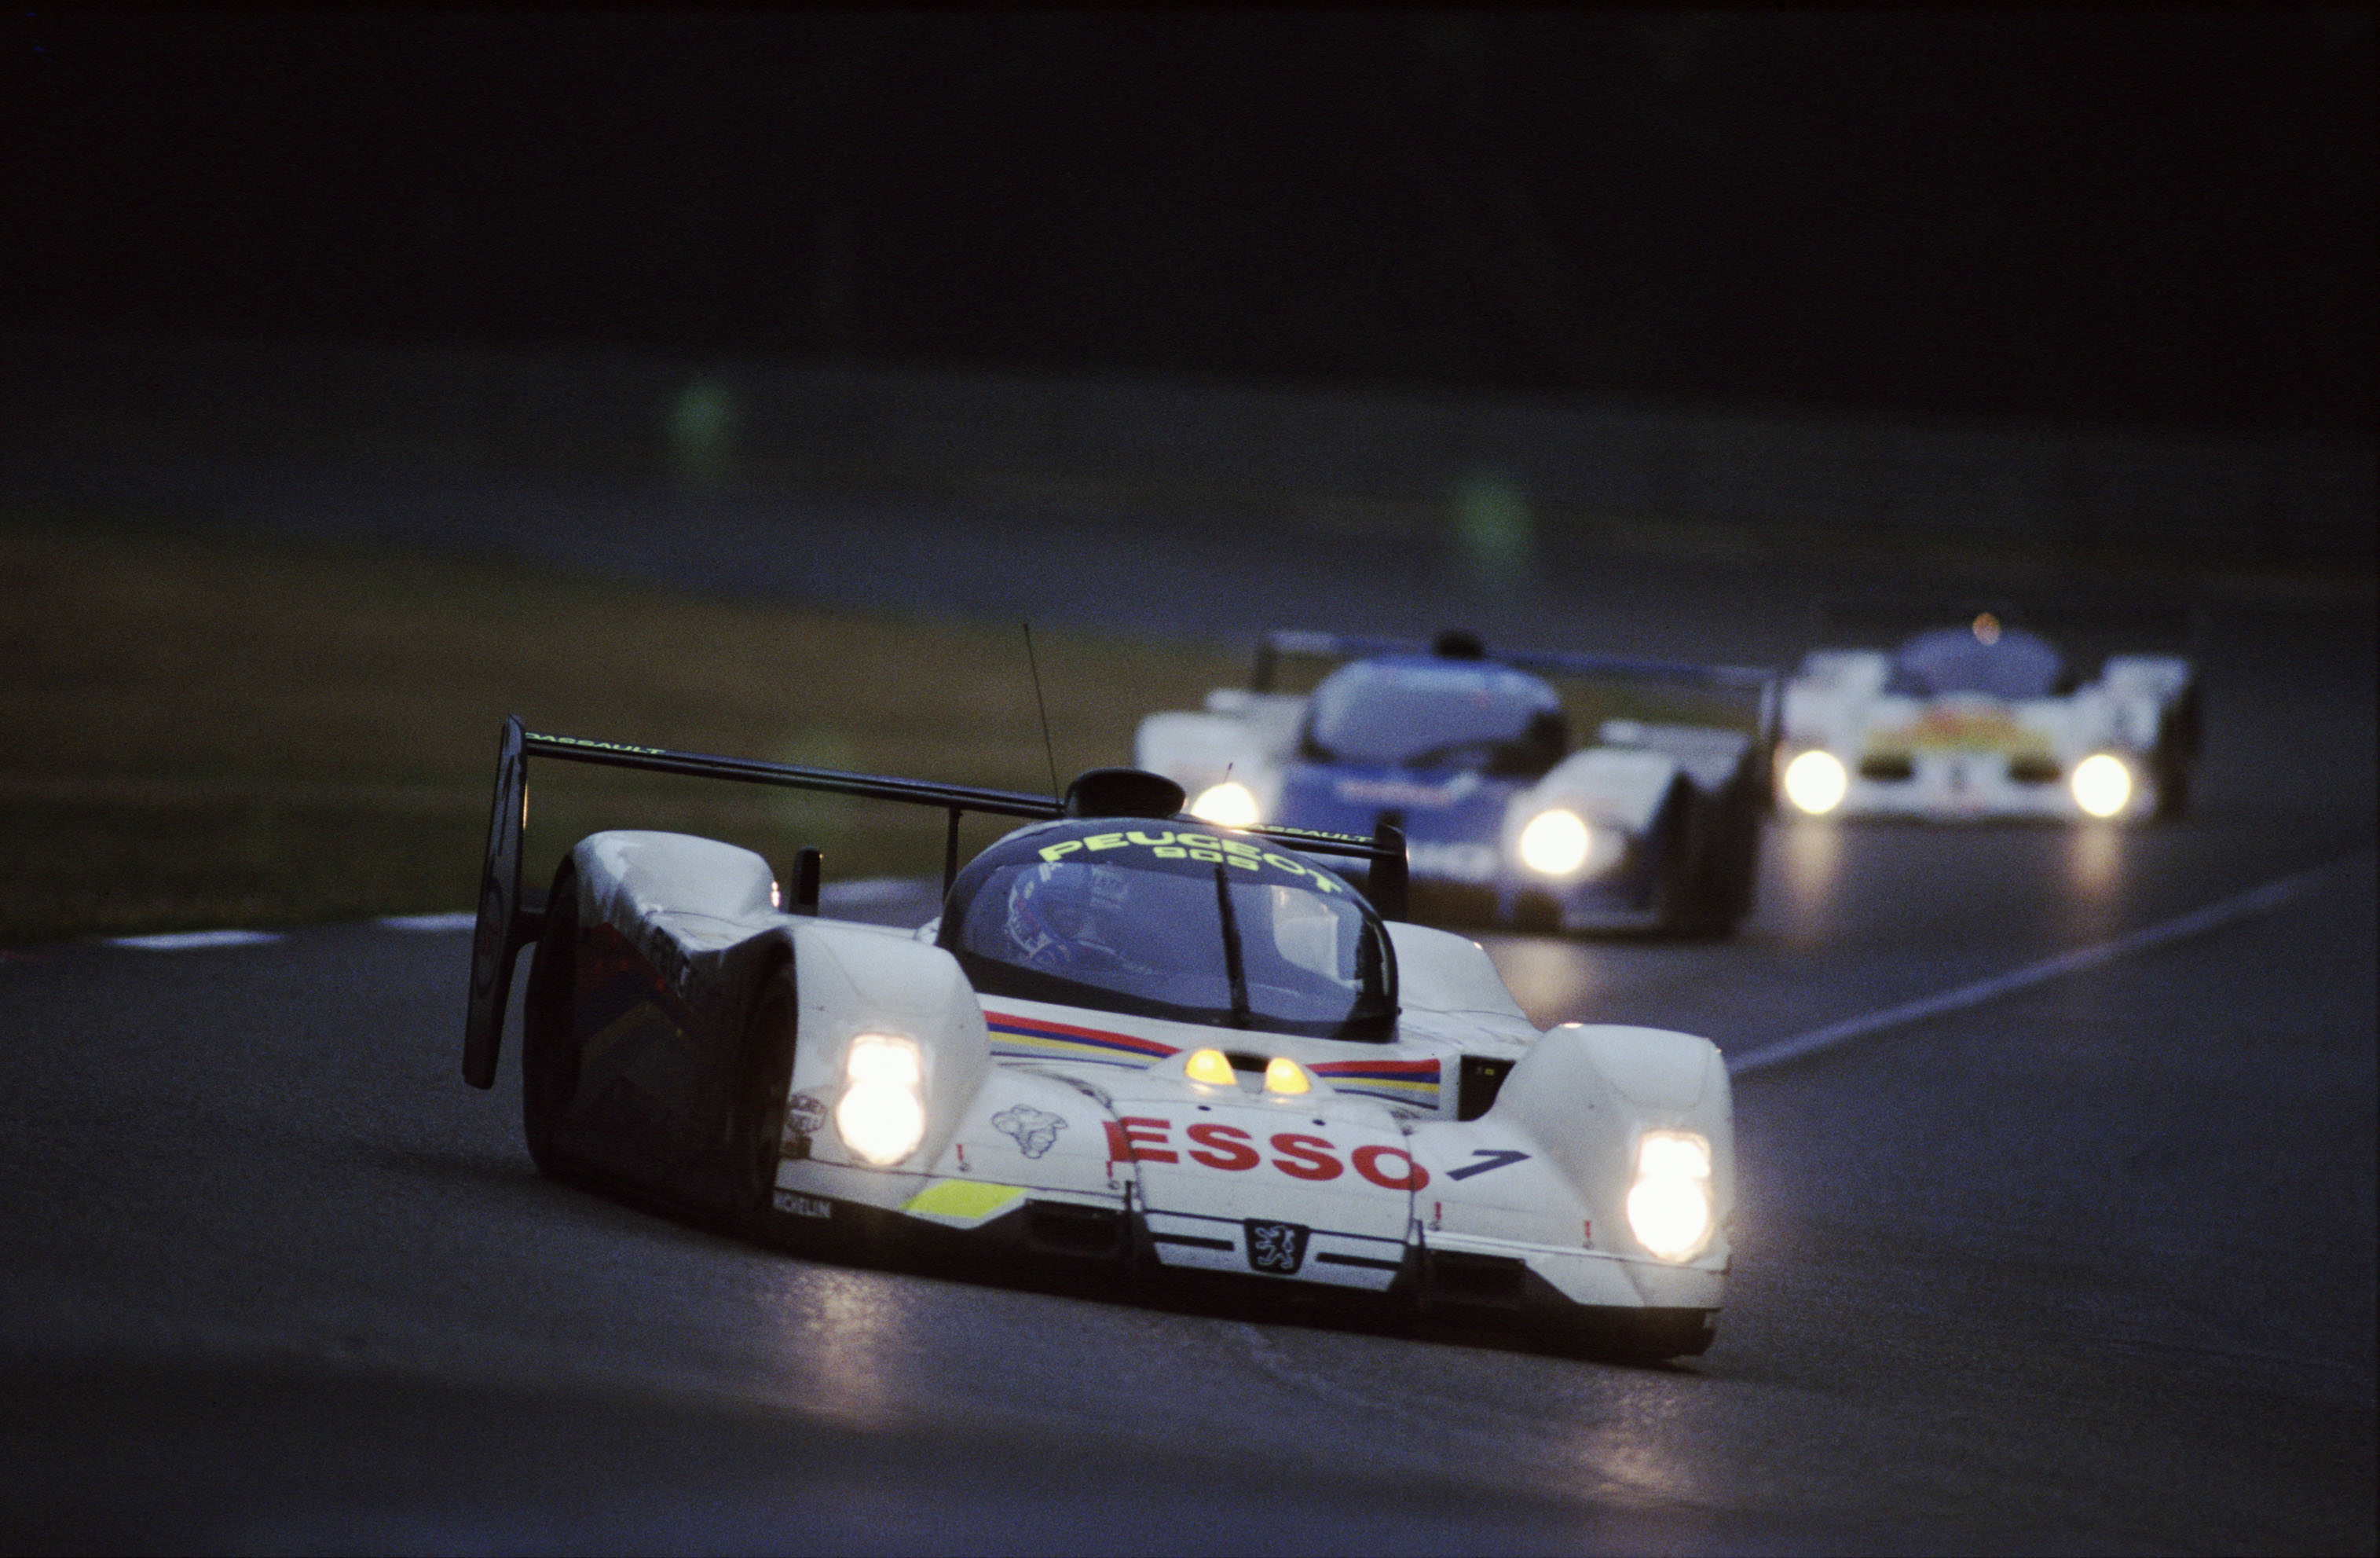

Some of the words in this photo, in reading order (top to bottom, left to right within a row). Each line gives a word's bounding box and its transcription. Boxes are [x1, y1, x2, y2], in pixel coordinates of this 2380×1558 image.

[1246, 824, 1374, 843] ASSAULT
[1038, 831, 1342, 894] PEUGEOT
[1152, 846, 1259, 872] 905
[1102, 1116, 1430, 1193] ESSO
